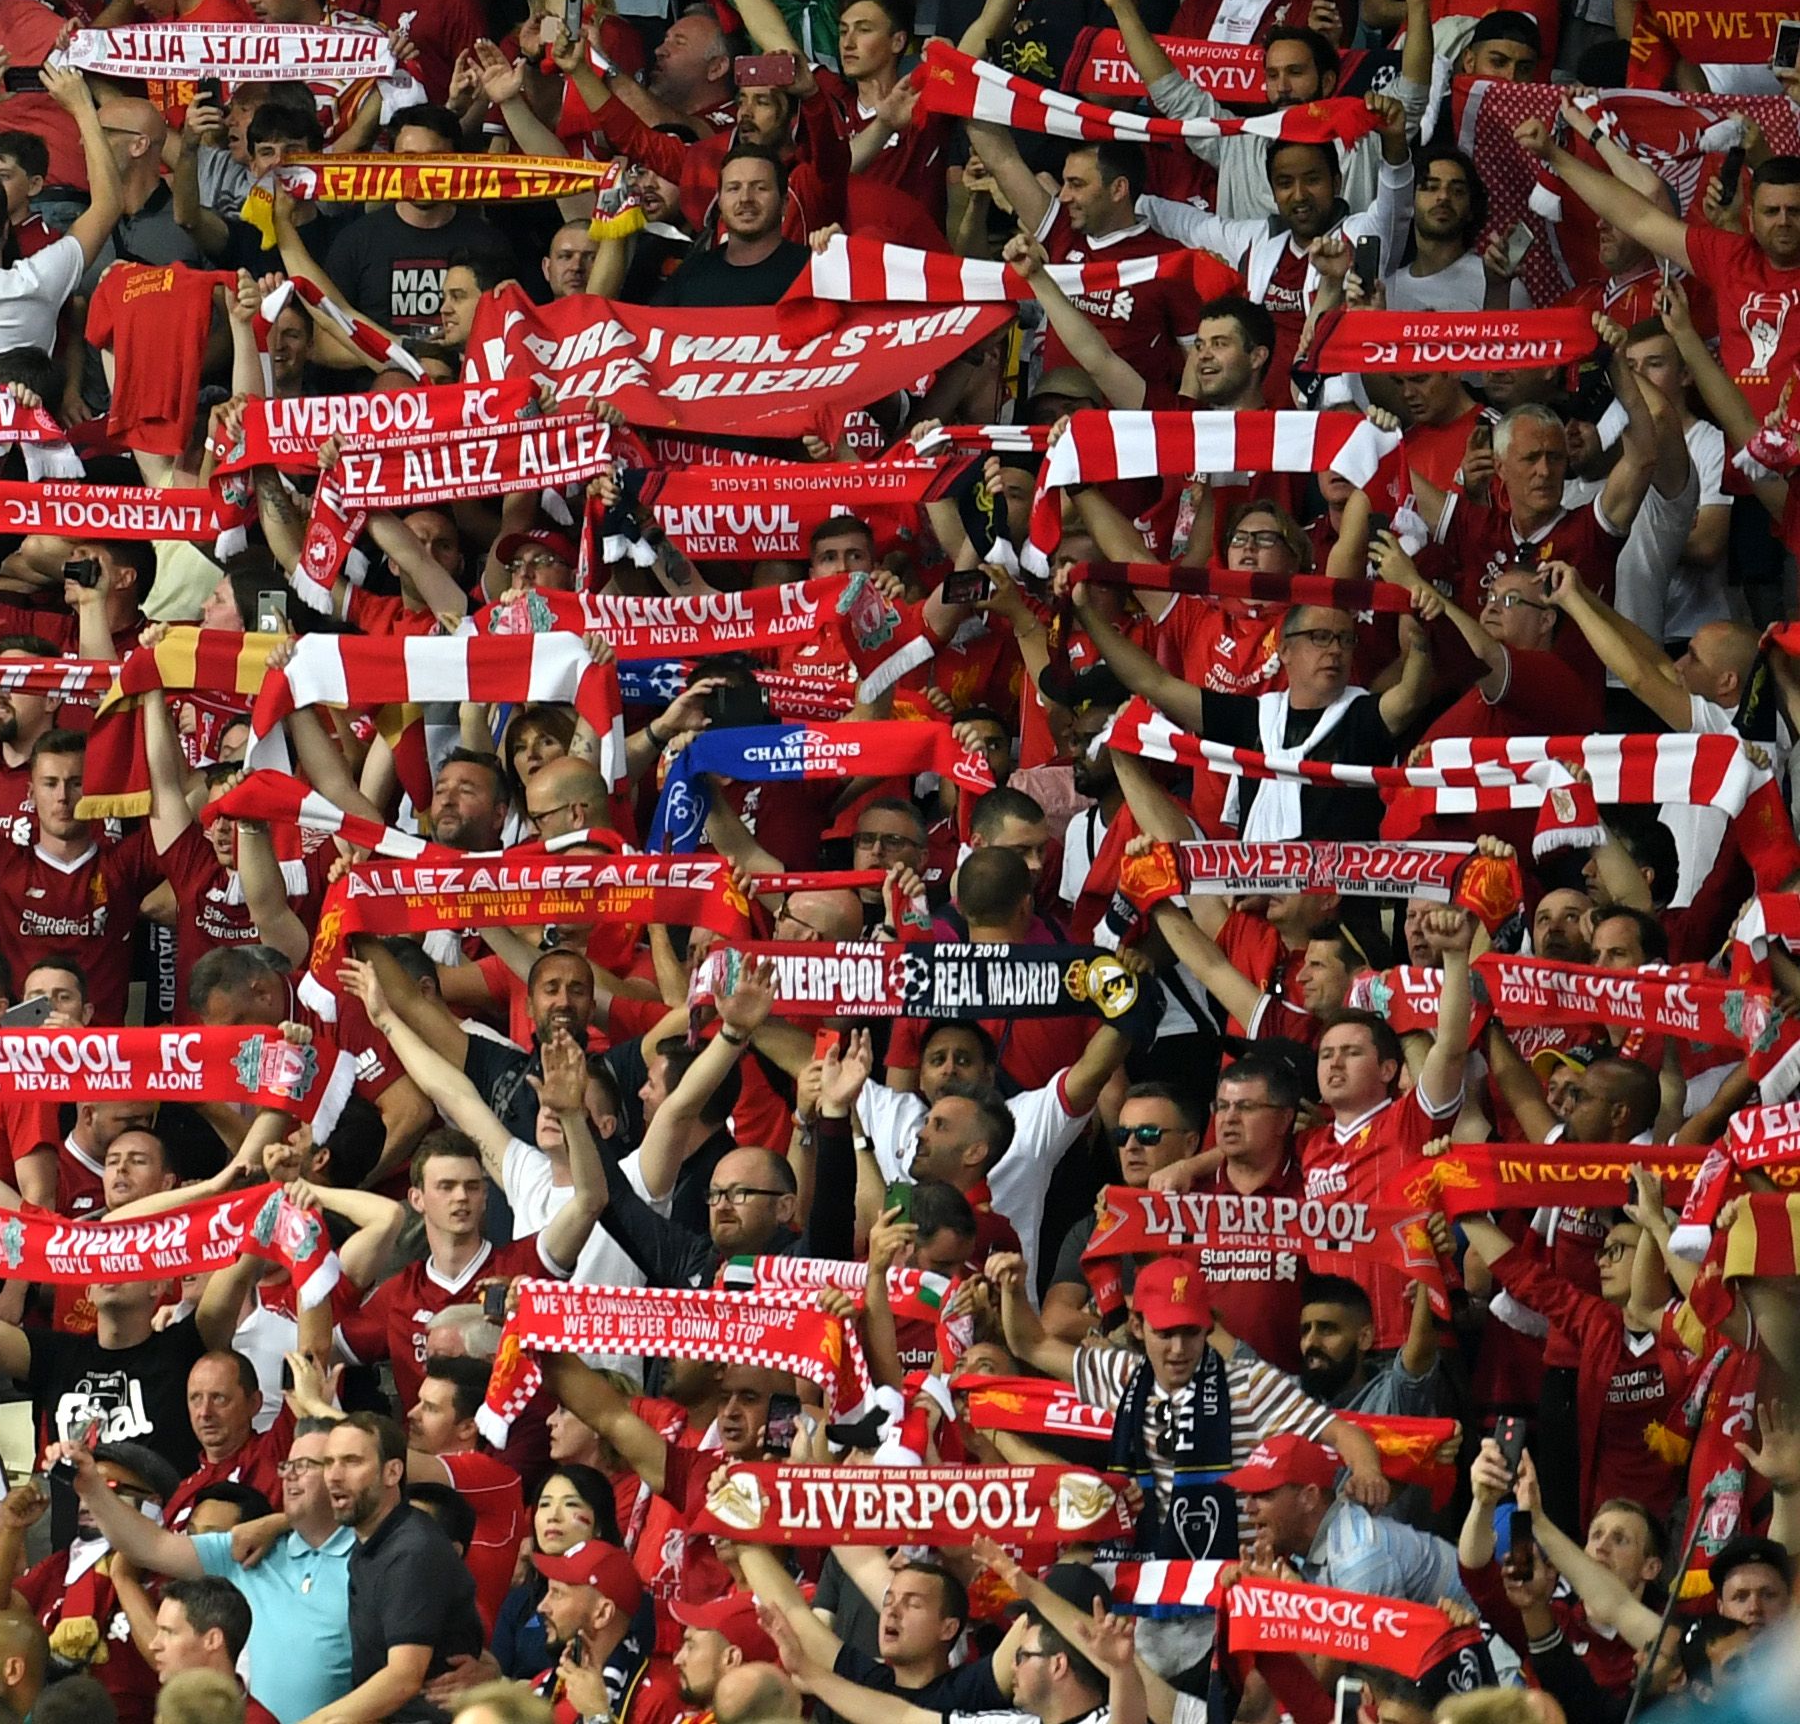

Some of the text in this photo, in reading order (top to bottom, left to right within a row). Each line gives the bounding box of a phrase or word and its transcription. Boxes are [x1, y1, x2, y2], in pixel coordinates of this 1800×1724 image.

[266, 388, 501, 438] LIVERPOOL FC
[403, 424, 612, 488] ALLEZ ALLEZ
[744, 741, 862, 762] CHAMPIONS
[770, 757, 841, 773] LEAGUE
[836, 942, 887, 958] FINAL
[934, 944, 1011, 958] KYIV 2018
[934, 960, 1061, 1006] REAL MADRID
[837, 1005, 958, 1019] CHAMPIONS LEAGUE
[158, 1033, 203, 1074] FC
[1142, 1195, 1376, 1244] LIVERPOOL
[1219, 1235, 1303, 1249] WALK ON
[530, 1292, 798, 1327] WE'VE CONQUERED ALL OF EUROPE
[564, 1315, 766, 1345] WE'RE NEVER GONNA STOP
[778, 1478, 1040, 1532] LIVERPOOL
